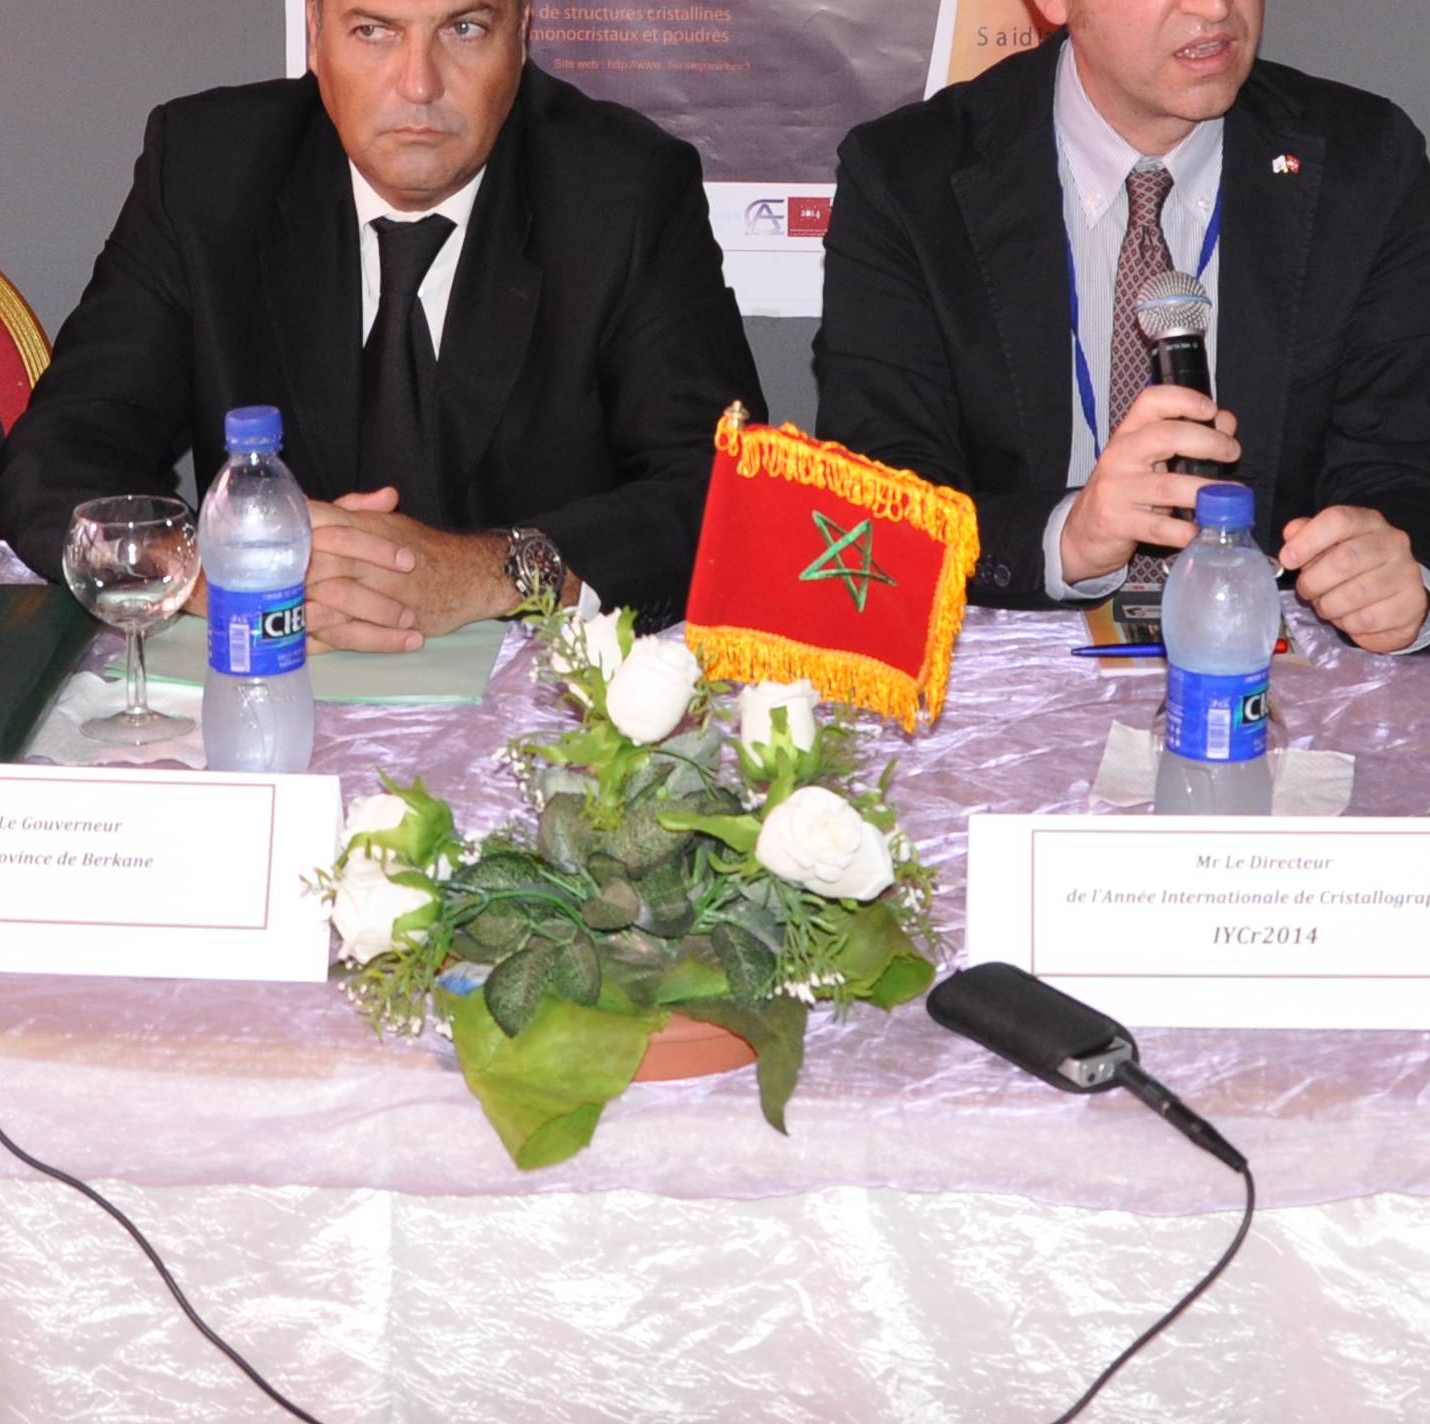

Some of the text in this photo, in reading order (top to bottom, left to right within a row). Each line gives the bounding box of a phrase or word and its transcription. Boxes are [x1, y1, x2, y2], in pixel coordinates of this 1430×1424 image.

[539, 3, 732, 22] de structures cristallines
[643, 28, 658, 43] et
[662, 27, 730, 46] poudres
[264, 606, 305, 637] CIE
[21, 815, 123, 834] Gouverneur
[56, 850, 77, 867] de
[81, 851, 154, 869] Berkane
[1195, 854, 1334, 871] Mr Le Directeur
[1066, 887, 1088, 905] de
[1091, 888, 1157, 905] l'Année
[1161, 889, 1289, 906] Internationale
[1294, 889, 1315, 906] de
[1212, 925, 1320, 946] IYCr2014
